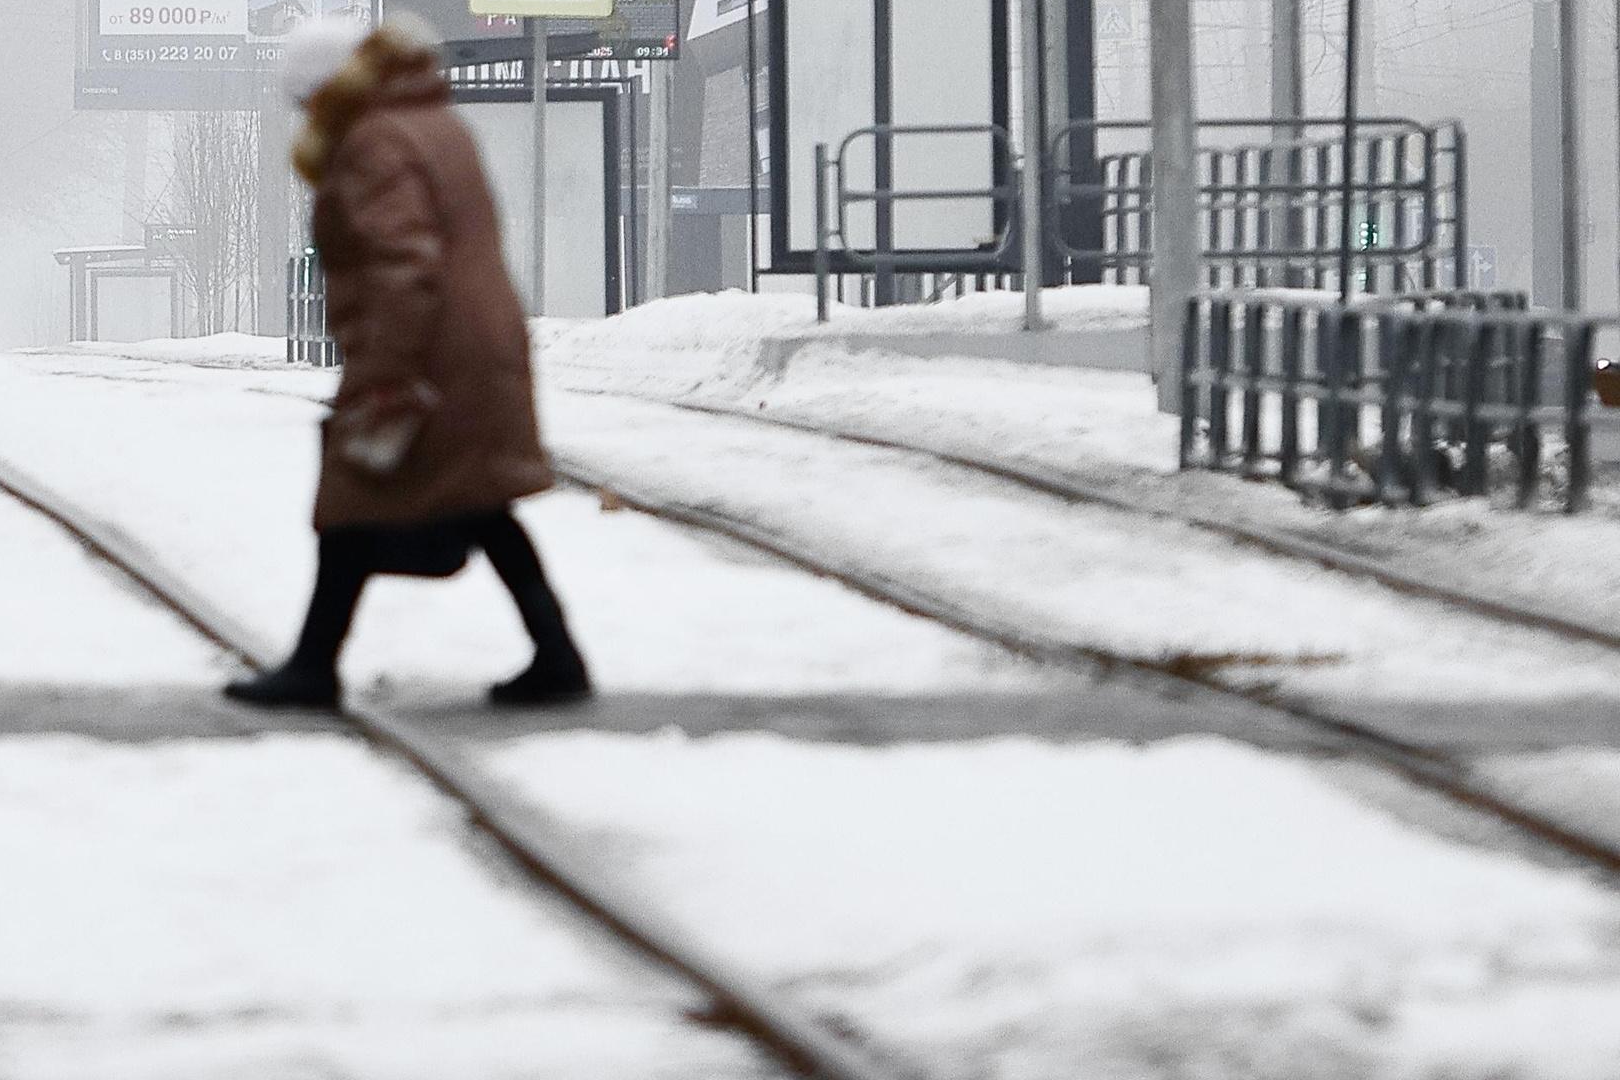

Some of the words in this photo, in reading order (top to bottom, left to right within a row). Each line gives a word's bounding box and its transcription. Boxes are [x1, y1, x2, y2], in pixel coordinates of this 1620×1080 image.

[129, 7, 154, 24] 89
[158, 7, 196, 24] 000
[159, 46, 189, 61] 223
[194, 46, 214, 61] 20
[218, 46, 238, 61] 07
